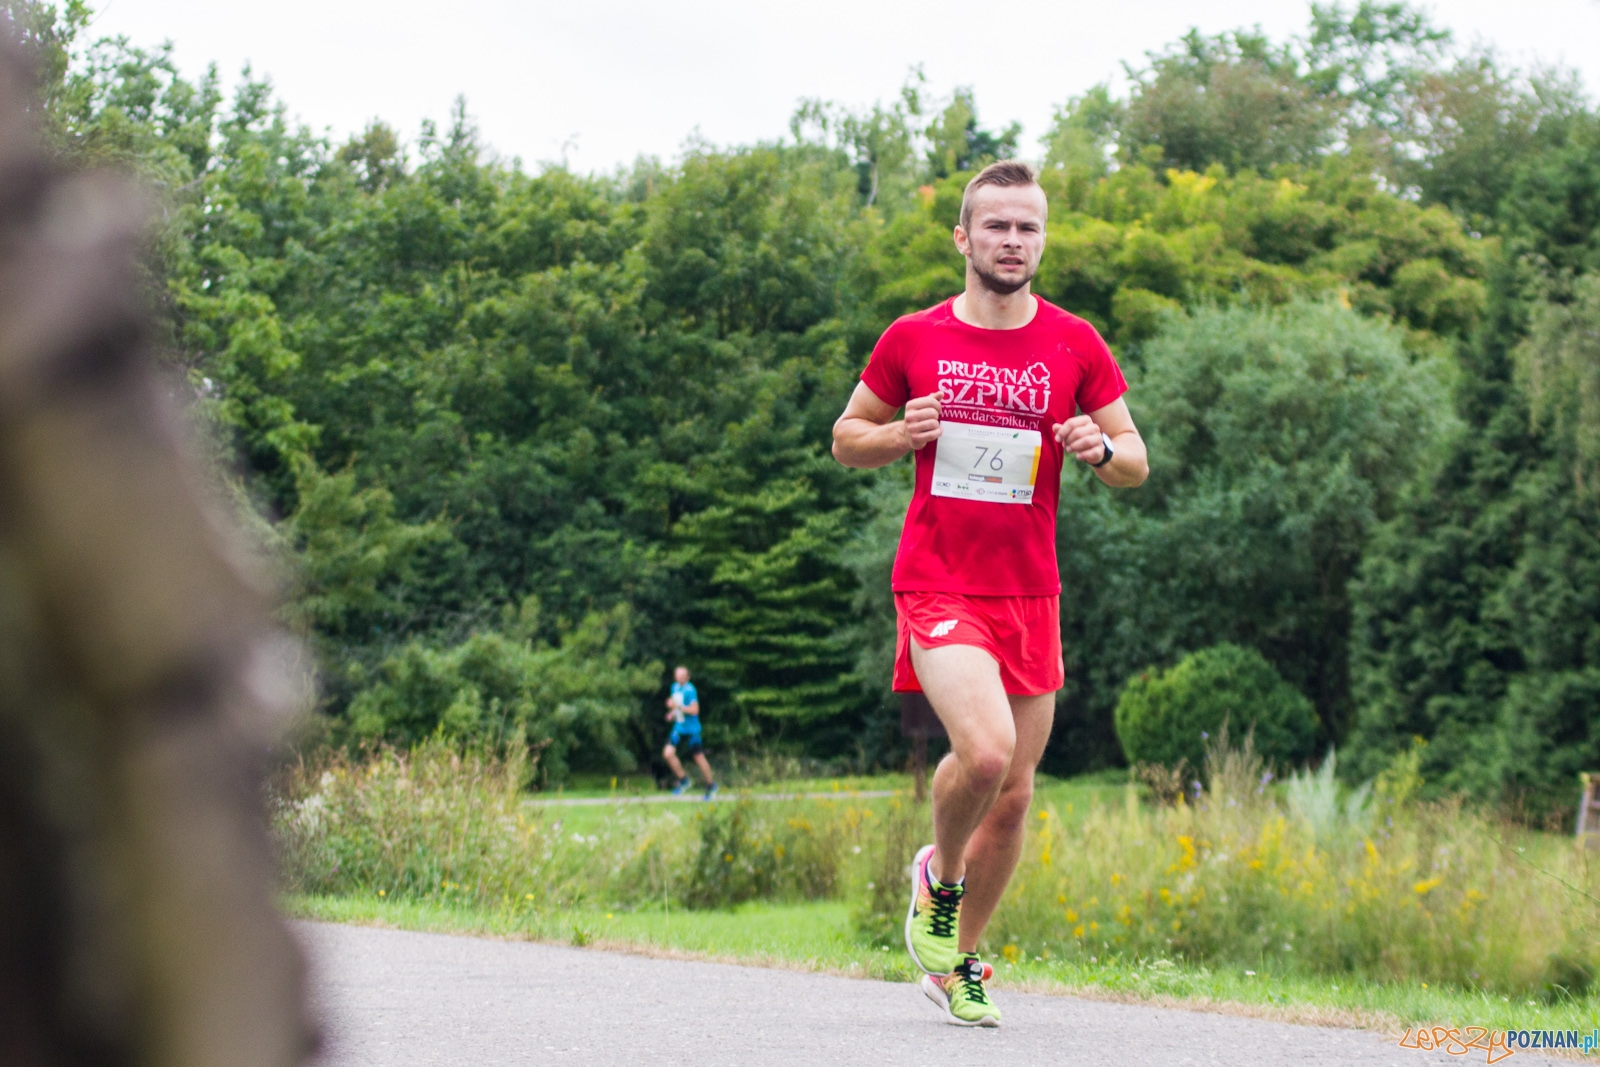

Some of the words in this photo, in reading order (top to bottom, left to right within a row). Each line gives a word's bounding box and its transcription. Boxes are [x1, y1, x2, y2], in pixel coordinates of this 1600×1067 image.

[937, 359, 1032, 387] DRUŻYNA
[938, 378, 1051, 414] SZPIKU
[973, 445, 1004, 471] 76
